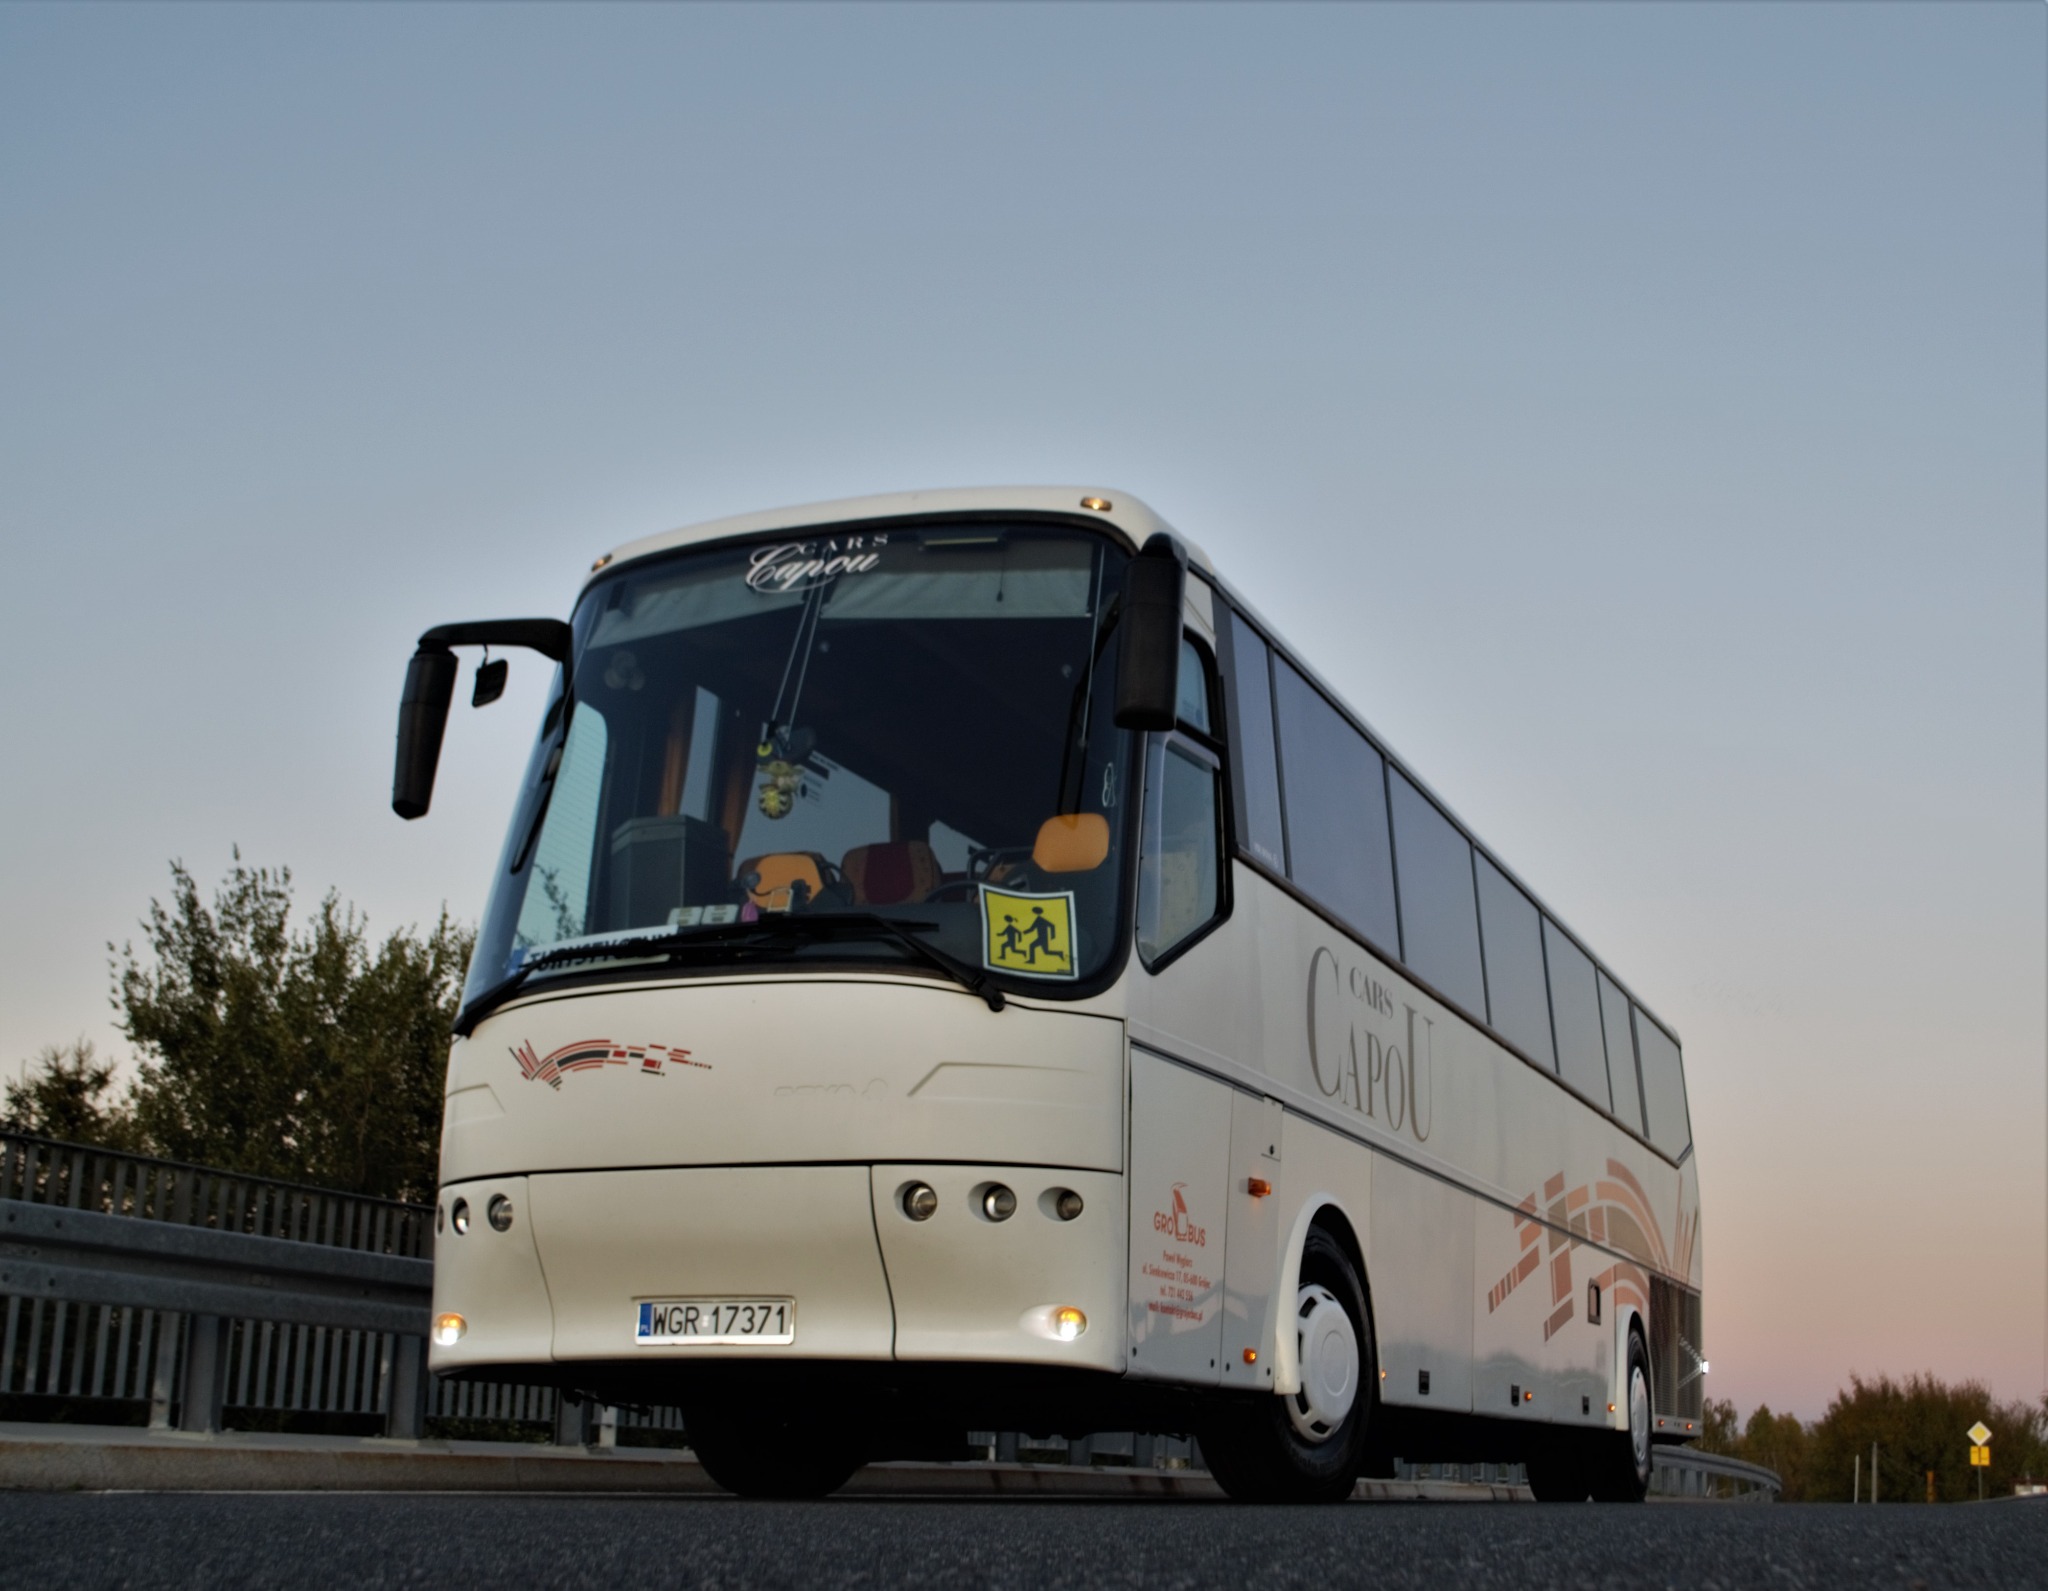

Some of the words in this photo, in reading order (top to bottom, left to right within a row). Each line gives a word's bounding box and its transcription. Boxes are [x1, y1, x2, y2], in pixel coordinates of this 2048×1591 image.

[800, 533, 888, 554] CARS
[745, 543, 880, 593] Capou
[1350, 966, 1394, 1020] CARS
[653, 1306, 700, 1335] WGR
[711, 1305, 786, 1335] 17371
